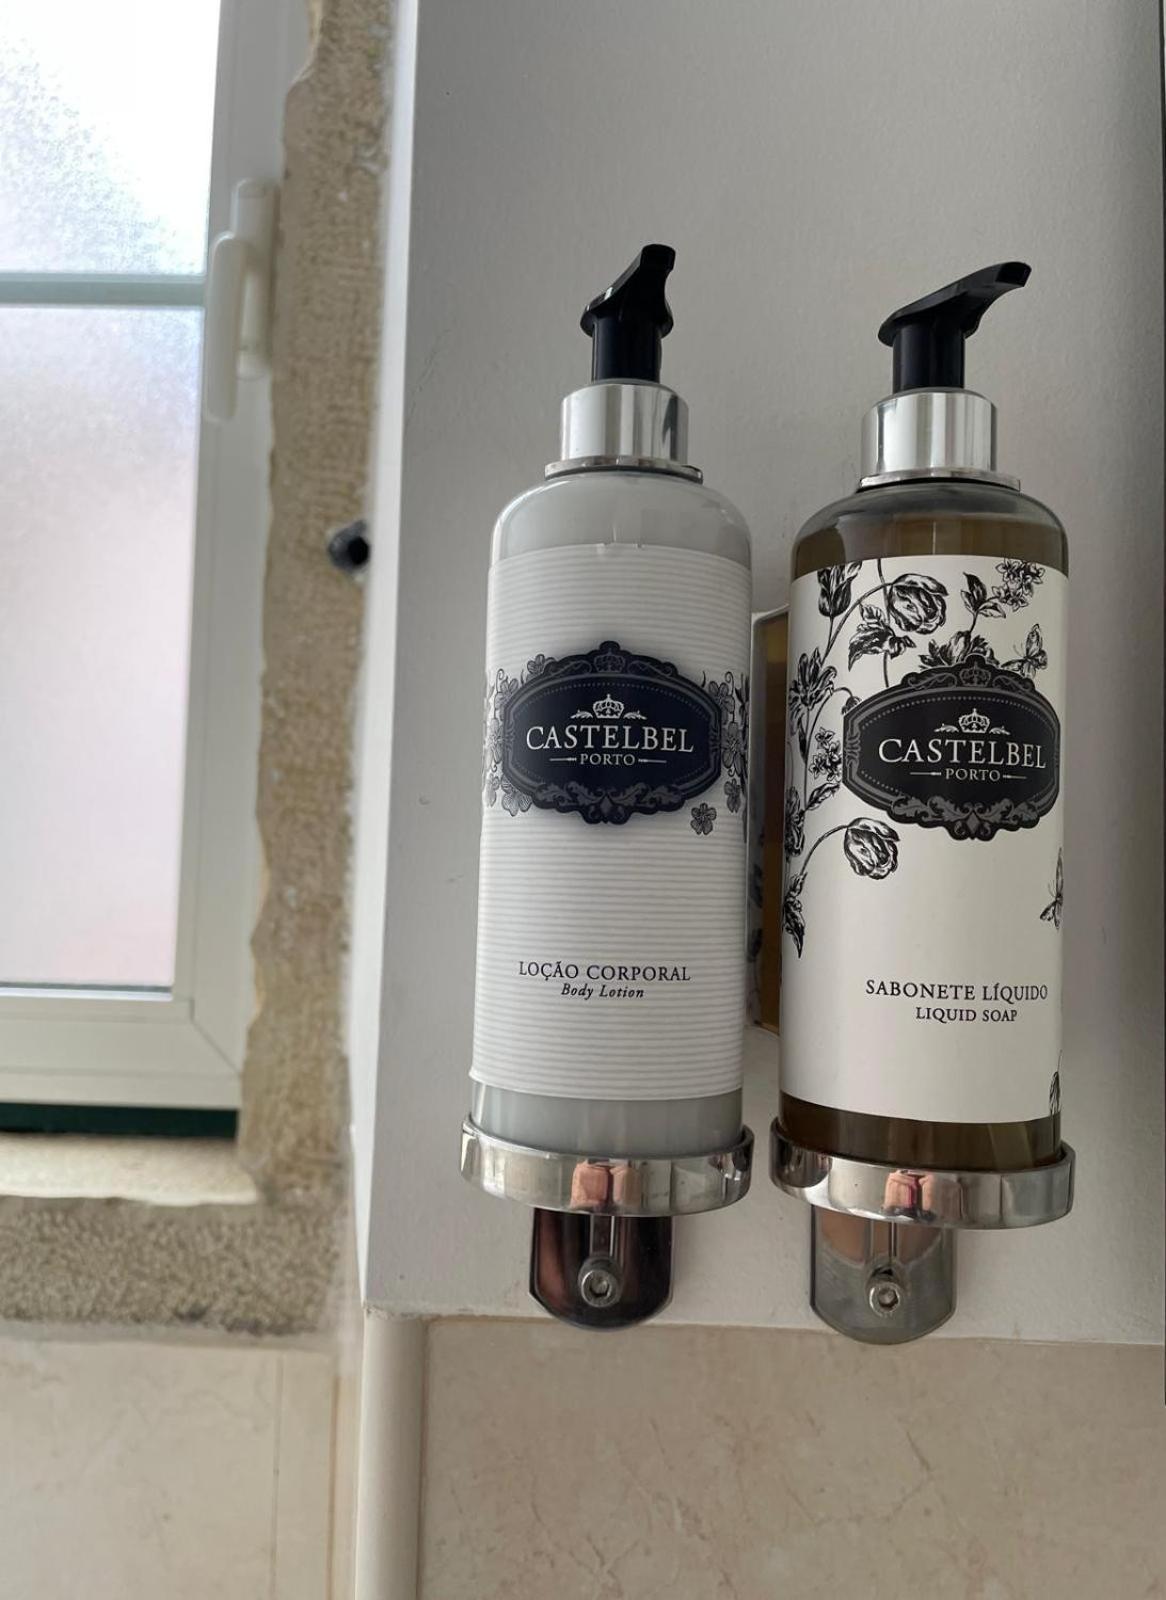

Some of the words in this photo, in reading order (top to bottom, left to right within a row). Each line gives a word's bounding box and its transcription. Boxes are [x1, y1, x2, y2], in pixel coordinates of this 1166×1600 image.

[526, 724, 694, 752] CASTELBEL
[580, 753, 636, 766] PORTO
[878, 738, 1046, 768] CASTELBEL
[945, 768, 1000, 782] PORTO
[519, 961, 579, 981] LOÇÃO
[586, 964, 691, 981] CORPORAL
[561, 983, 594, 1000] Body
[599, 984, 644, 998] Lotion
[865, 979, 976, 1000] SABONETE
[982, 982, 1048, 1004] LÍQUIDO
[916, 1006, 977, 1024] LIQUID
[982, 1009, 1018, 1022] SOAP
